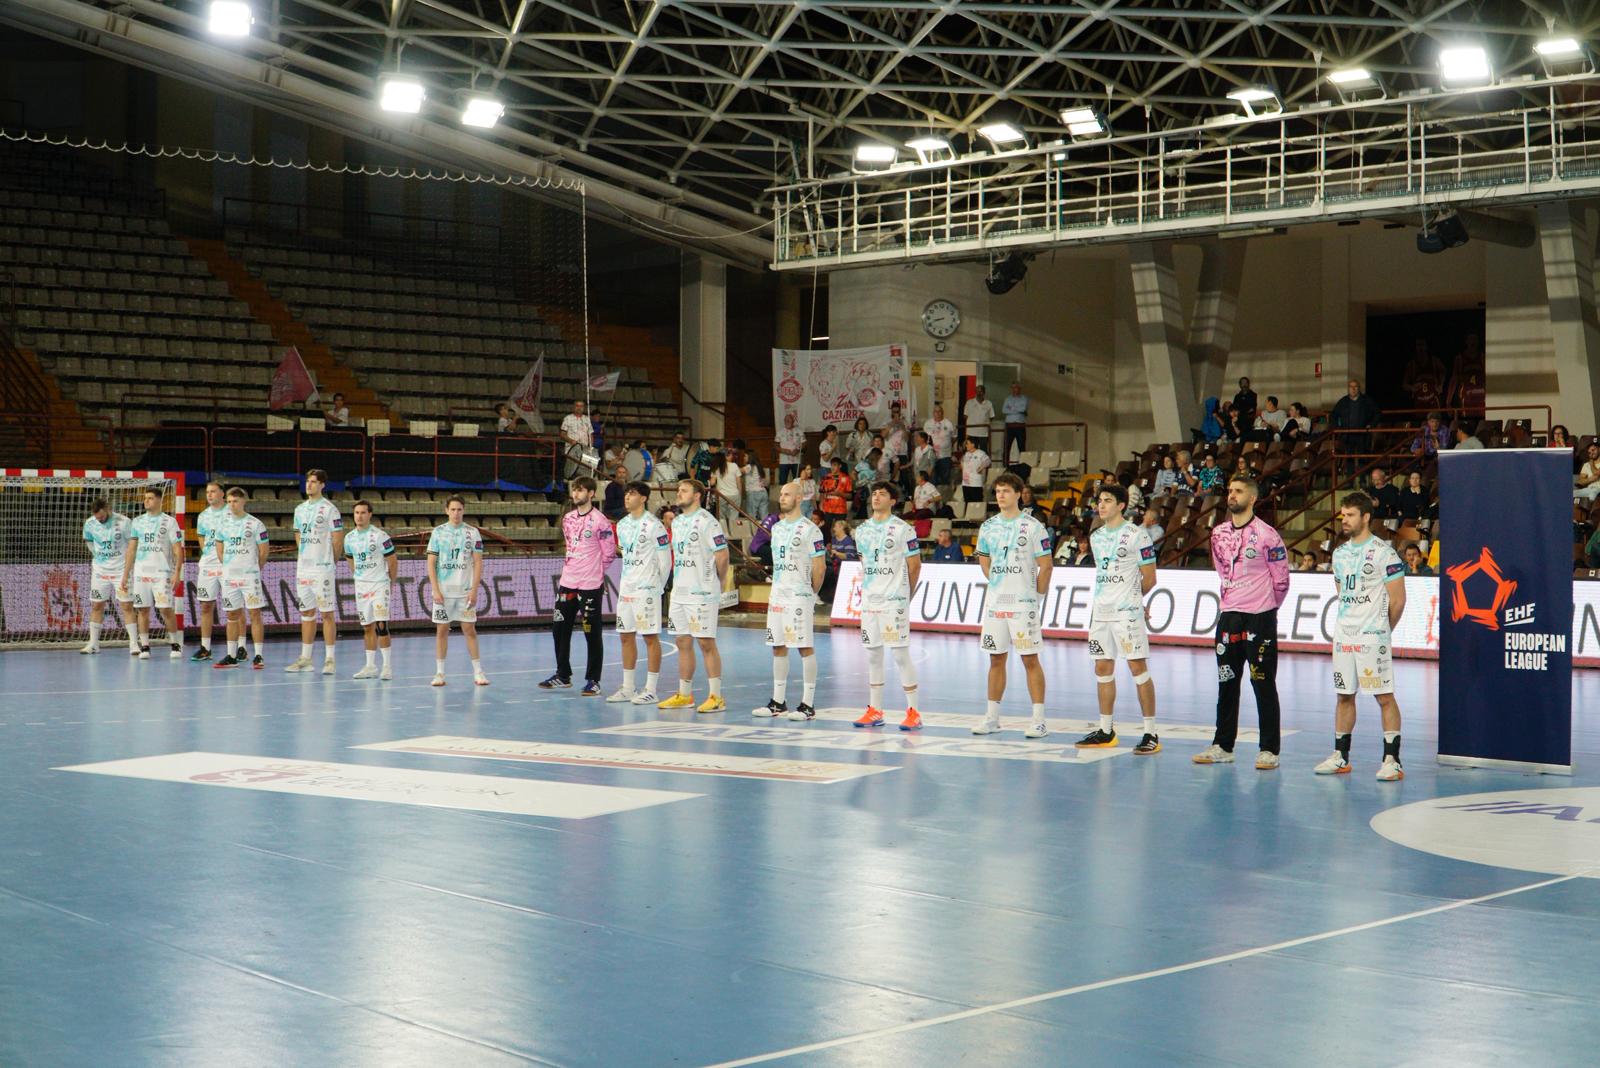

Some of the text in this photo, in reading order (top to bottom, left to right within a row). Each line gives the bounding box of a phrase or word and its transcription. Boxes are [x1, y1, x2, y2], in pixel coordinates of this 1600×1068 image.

[889, 380, 904, 391] SOY
[302, 522, 312, 534] 24
[144, 532, 155, 543] 66
[230, 536, 242, 546] 30
[451, 548, 461, 560] 17
[780, 545, 786, 559] 9
[1002, 546, 1009, 560] 7
[991, 565, 1023, 575] ABANCA
[1096, 575, 1125, 585] BANCA
[1345, 574, 1356, 591] 10
[1505, 602, 1536, 623] EHF
[1504, 632, 1566, 653] EUROPEAN
[1504, 651, 1548, 671] LEAGUE
